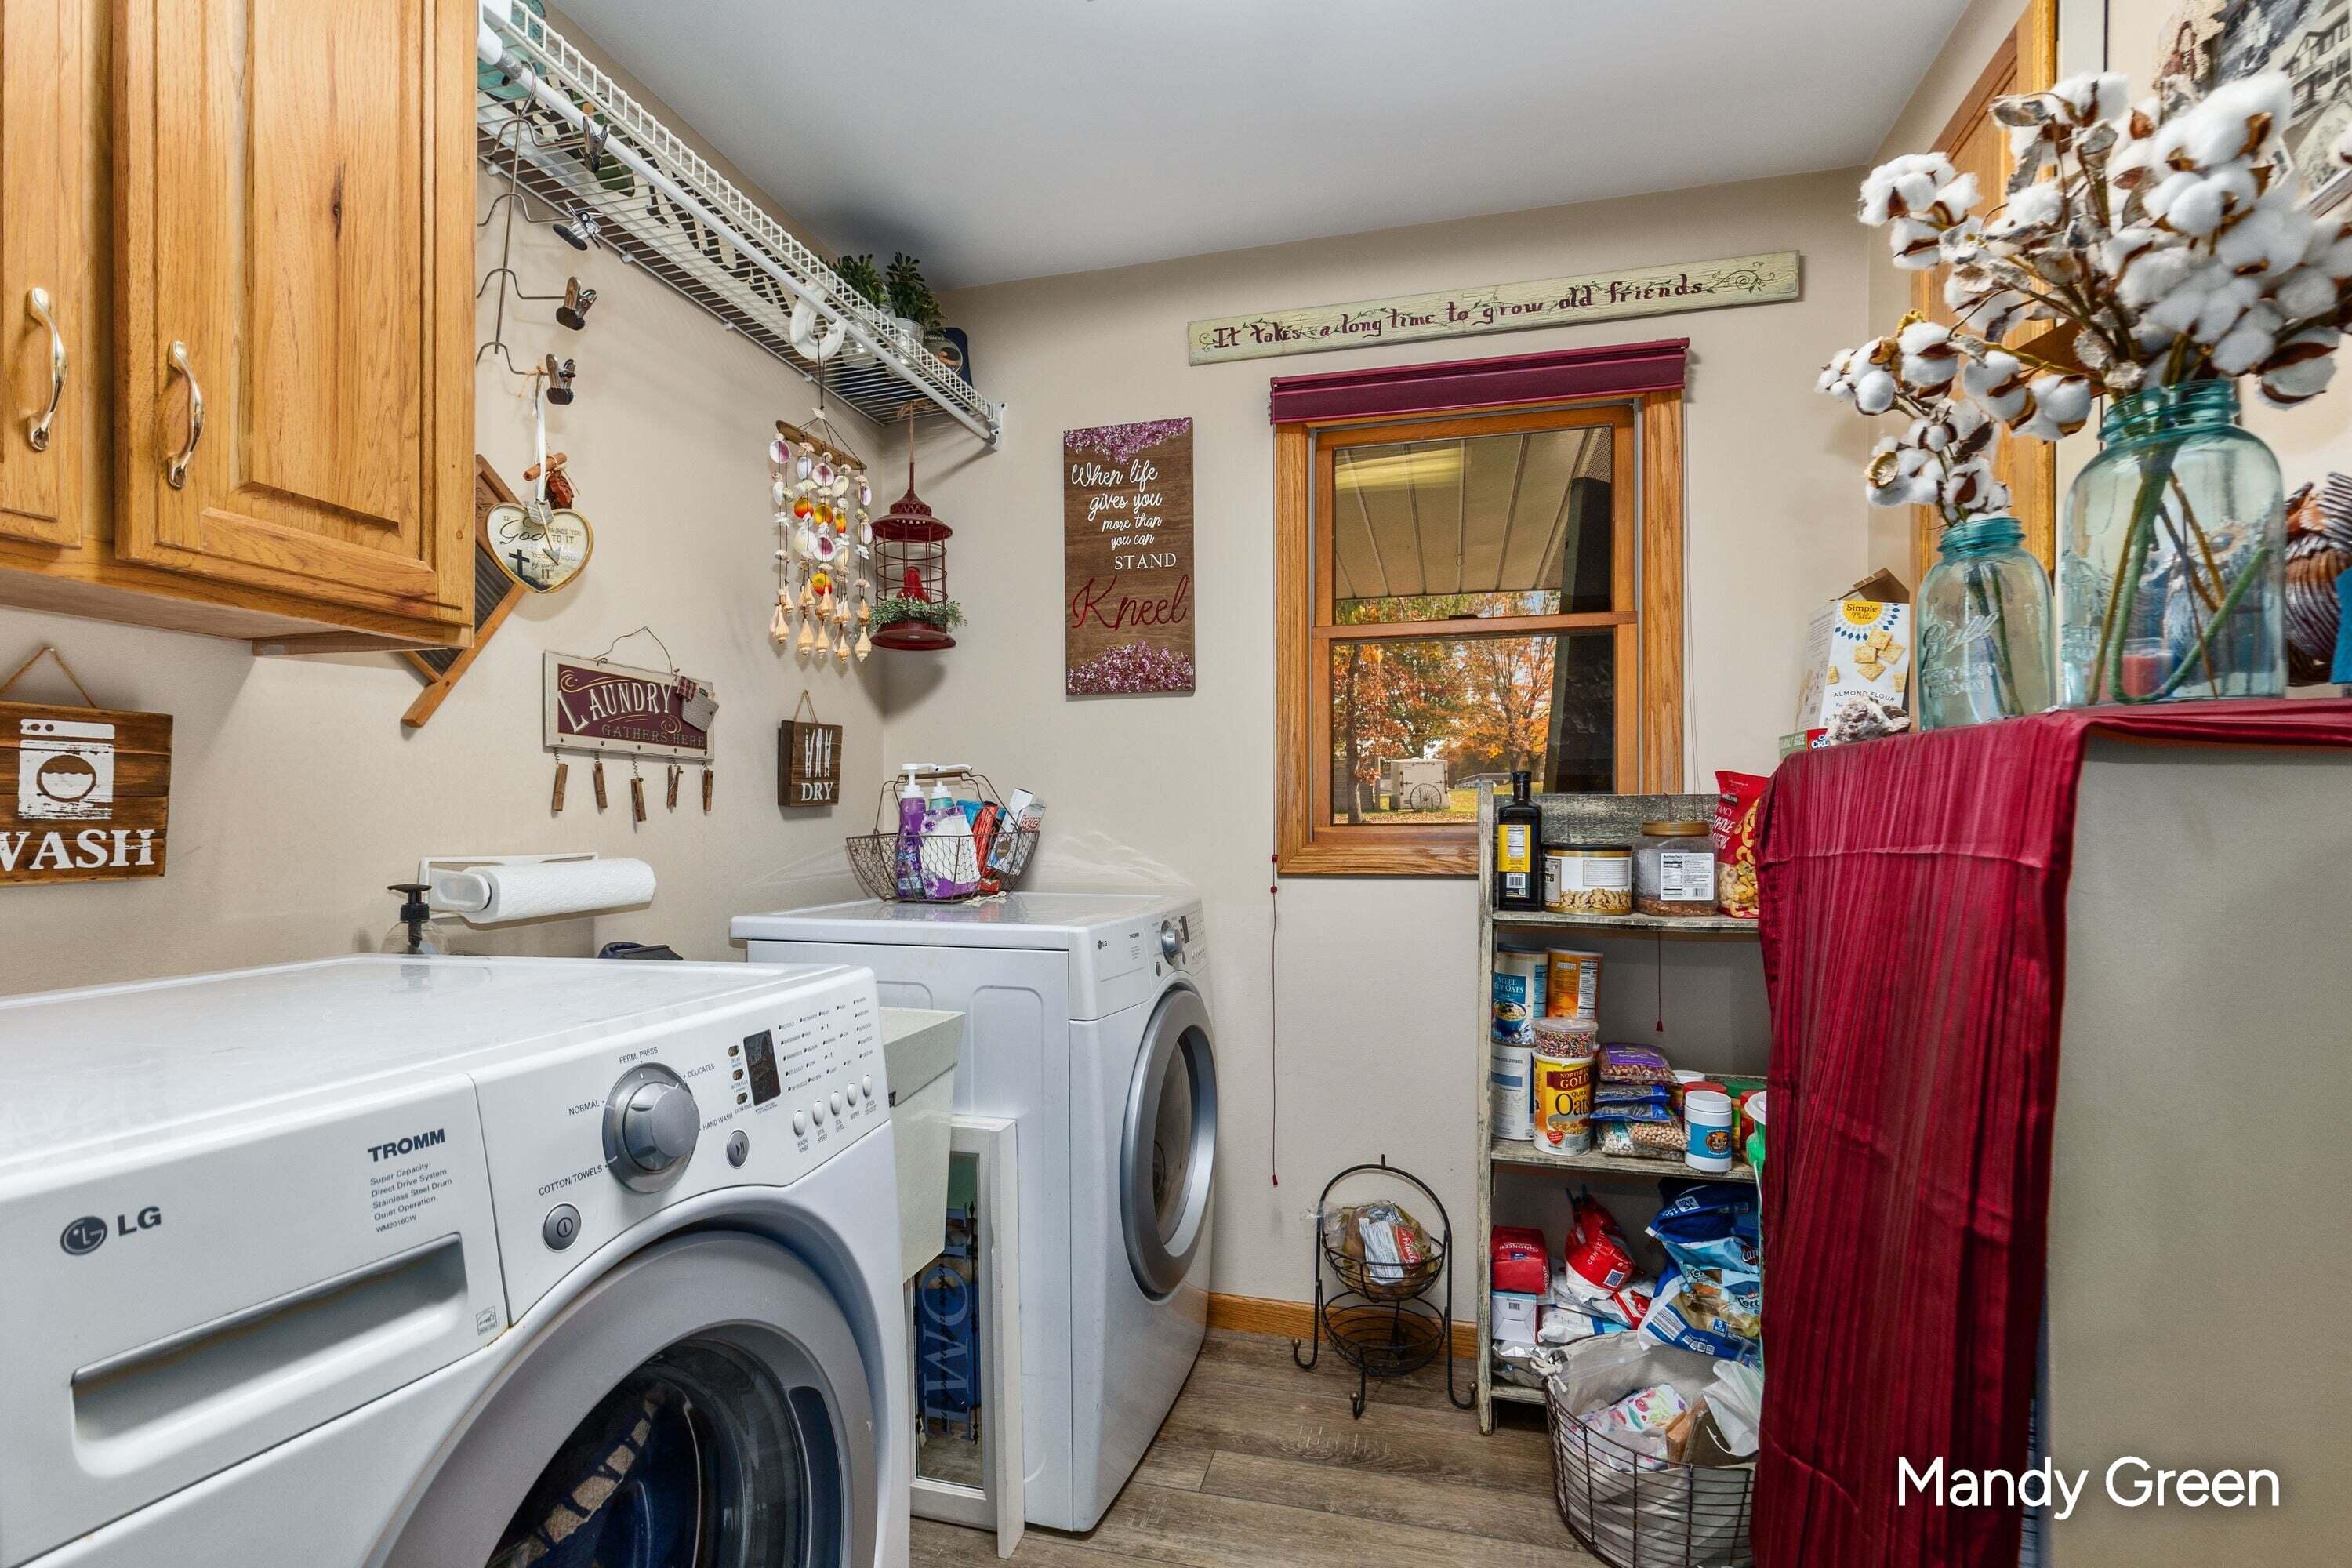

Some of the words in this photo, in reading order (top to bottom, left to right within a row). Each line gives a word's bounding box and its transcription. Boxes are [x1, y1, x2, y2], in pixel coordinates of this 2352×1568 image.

[1213, 327, 1240, 349] It
[1250, 321, 1301, 344] takes
[1319, 325, 1330, 337] a
[1341, 313, 1382, 339] long
[1387, 308, 1436, 328] time
[1447, 301, 1469, 323] to
[1471, 301, 1544, 327] grow
[1559, 285, 1594, 310] old
[1609, 274, 1704, 305] friends
[1072, 462, 1123, 487] When
[1130, 459, 1159, 492] life
[1087, 493, 1129, 521] gives
[1133, 492, 1163, 514] you
[499, 516, 546, 545] God
[548, 526, 569, 535] BRINGS
[571, 528, 582, 537] YOU
[1102, 518, 1131, 532] more
[1134, 513, 1162, 528] than
[551, 534, 563, 543] TO
[565, 535, 575, 544] IT
[1111, 537, 1132, 551] you
[1133, 533, 1155, 545] can
[1114, 553, 1177, 570] STAND
[541, 569, 551, 579] IT
[1072, 574, 1189, 631] Kneel
[1846, 603, 1878, 613] Simple
[557, 682, 672, 733] LAUNDRY
[1870, 691, 1896, 703] FLOUR
[601, 724, 667, 743] GATHERS
[673, 734, 705, 747] HERE
[800, 782, 833, 801] DRY
[1505, 985, 1524, 993] OATS
[619, 1052, 638, 1065] PERM.
[639, 1047, 659, 1059] PRESS
[688, 1063, 715, 1078] DELICATES
[1560, 1073, 1589, 1088] GOLD
[568, 1100, 601, 1116] NORMAL
[1555, 1093, 1591, 1116] Oats
[702, 1120, 718, 1131] HAND
[718, 1113, 733, 1124] WASH
[368, 1128, 445, 1162] TROMM
[370, 1173, 394, 1185] Super
[396, 1163, 429, 1178] Capacity
[371, 1185, 395, 1198] Direct
[397, 1178, 418, 1190] Drive
[419, 1168, 447, 1183] System
[539, 1165, 603, 1196] COTTON/TOWELS
[372, 1194, 409, 1210] Stainless
[411, 1185, 430, 1197] Steel
[431, 1178, 452, 1191] Drum
[374, 1209, 396, 1221] Quiet
[397, 1195, 436, 1214] Operation
[117, 1206, 162, 1236] LG
